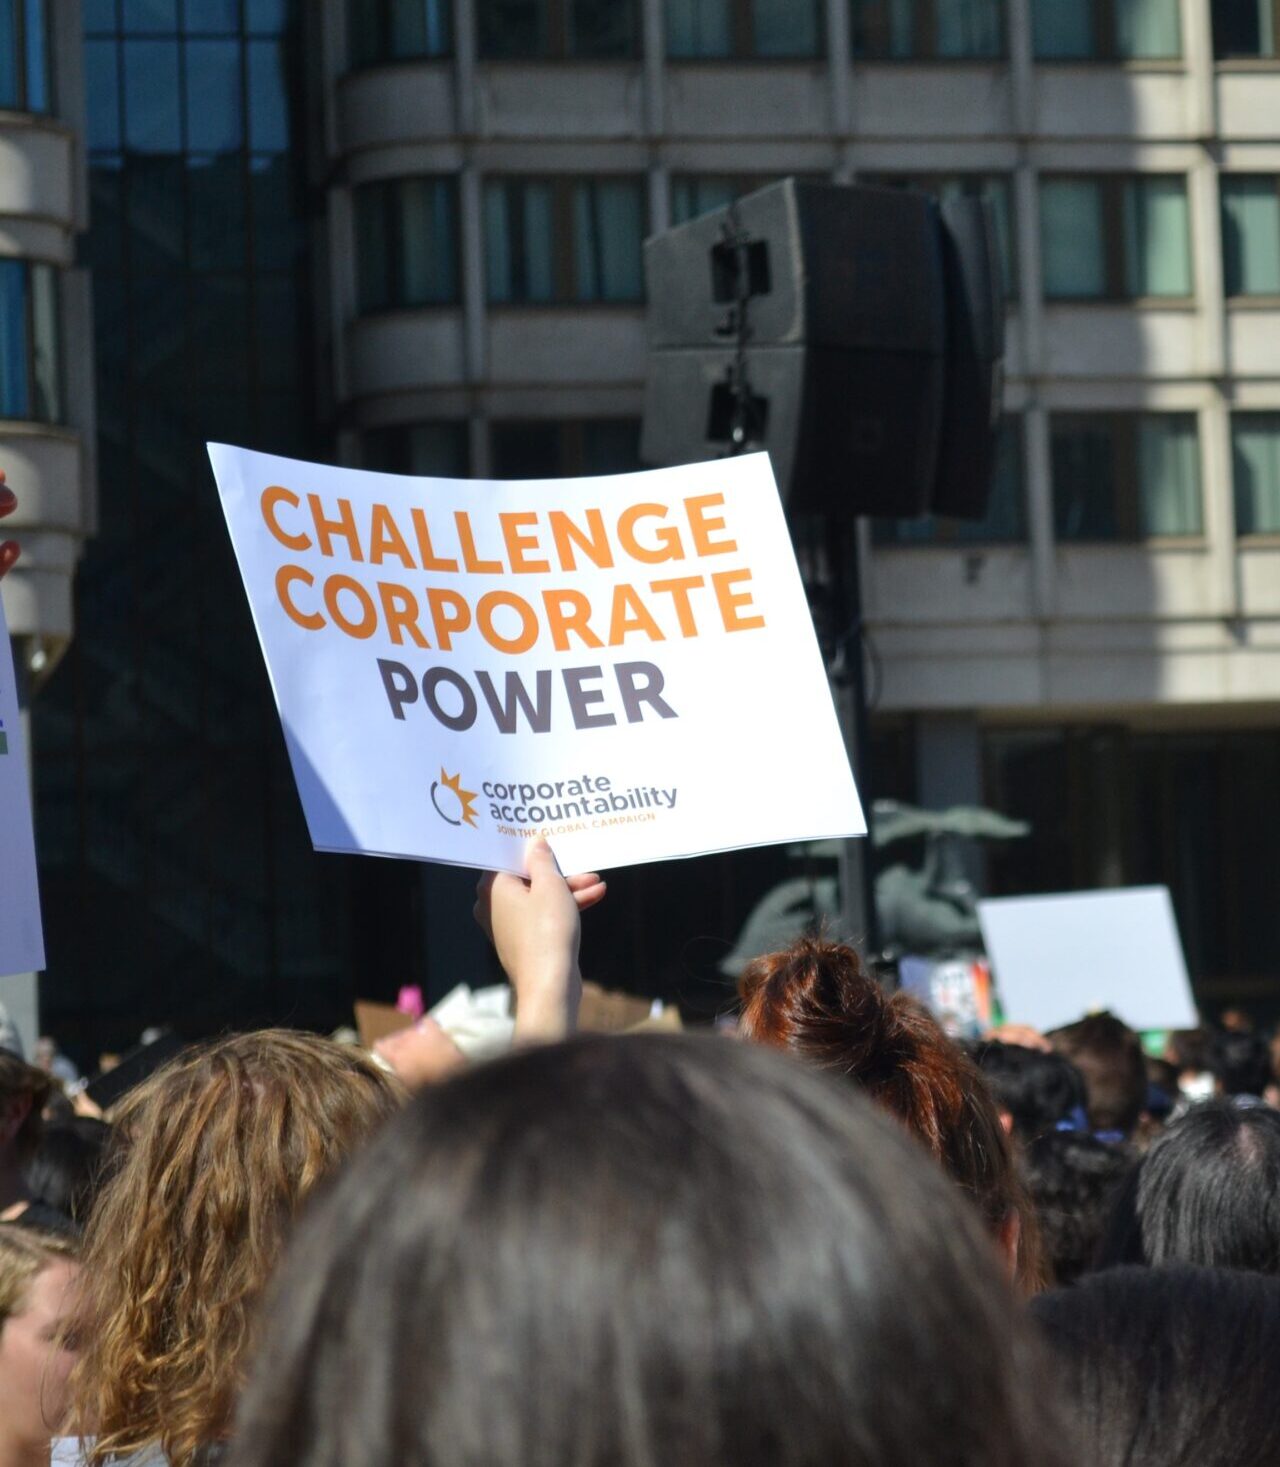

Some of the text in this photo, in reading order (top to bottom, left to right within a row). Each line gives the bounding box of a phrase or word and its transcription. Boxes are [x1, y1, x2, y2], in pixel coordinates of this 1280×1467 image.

[262, 486, 737, 574] CHALLENGE
[276, 565, 764, 654] CORPORATE
[376, 657, 678, 734] POWER
[482, 774, 611, 806] corporate
[490, 787, 678, 824] accountability
[541, 821, 590, 838] GLOBAL
[592, 811, 657, 829] CAMPAIGN
